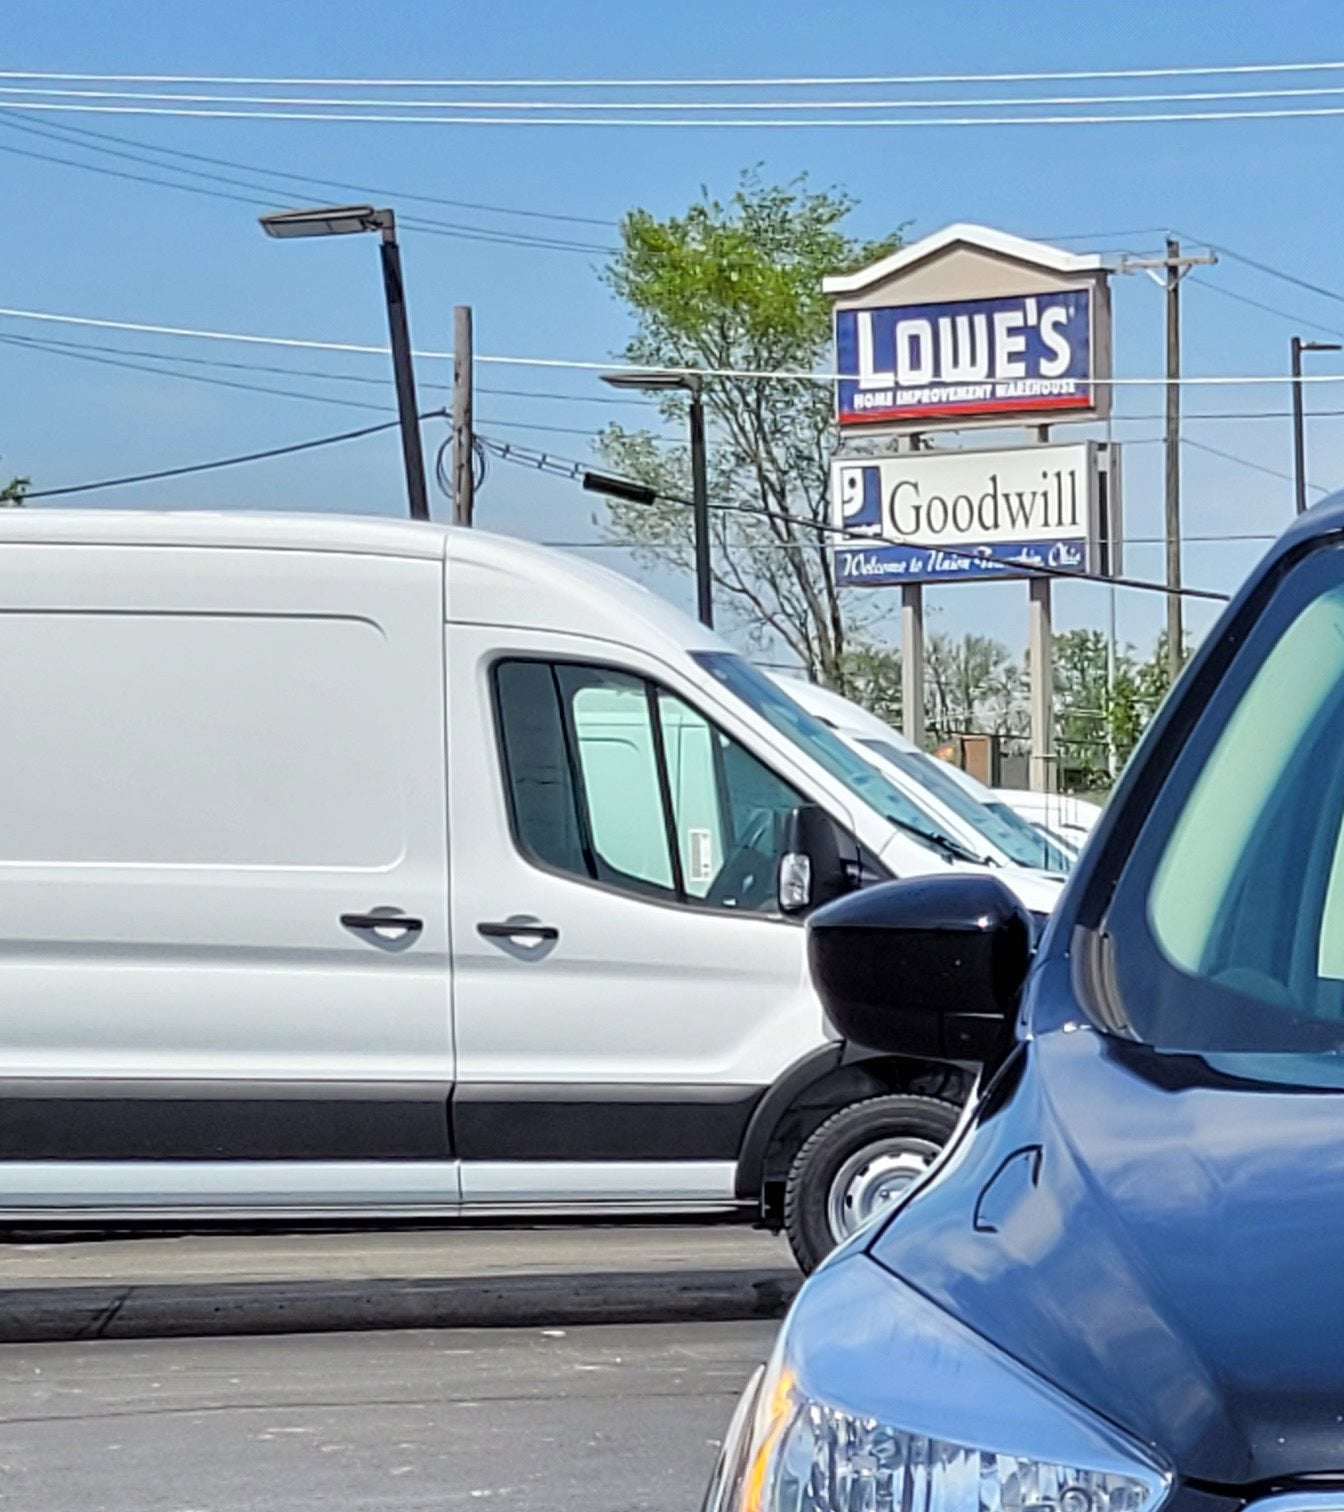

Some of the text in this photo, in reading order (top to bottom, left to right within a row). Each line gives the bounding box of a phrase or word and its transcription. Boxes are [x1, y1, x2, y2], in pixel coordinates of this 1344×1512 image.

[857, 298, 1072, 389] LOWE'S
[853, 379, 1076, 410] HOME IMPROVEMENT WAREHOUSE
[889, 470, 1080, 535] Goodwill
[843, 553, 906, 577] Welcome
[909, 557, 923, 573] to
[927, 550, 971, 573] Union
[1048, 542, 1082, 567] Ohio
